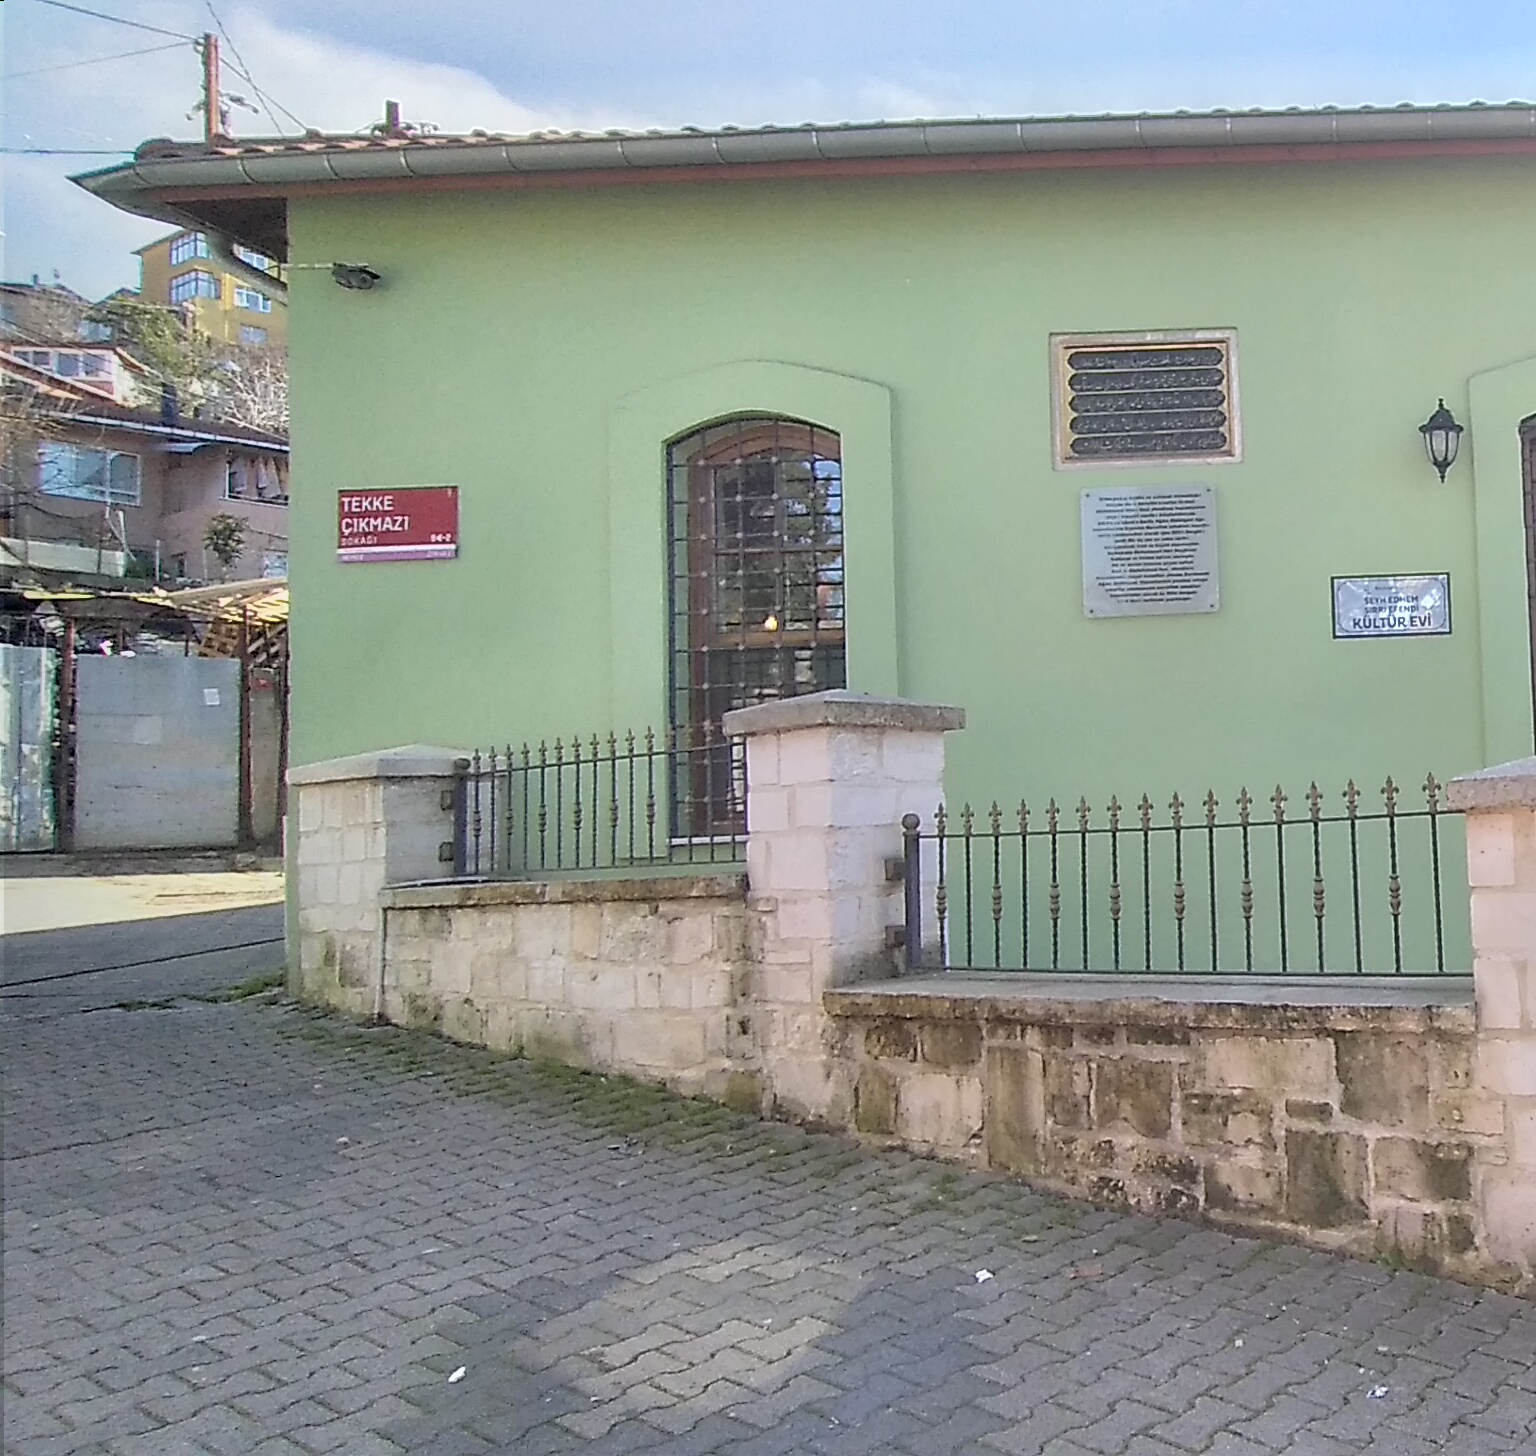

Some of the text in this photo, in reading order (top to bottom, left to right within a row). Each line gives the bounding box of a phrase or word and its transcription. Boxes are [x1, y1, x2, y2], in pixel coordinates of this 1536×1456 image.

[341, 495, 394, 512] TEKKE
[341, 515, 409, 536] ÇIKMAZI
[1352, 612, 1432, 629] KÜLTÜR EVİ
